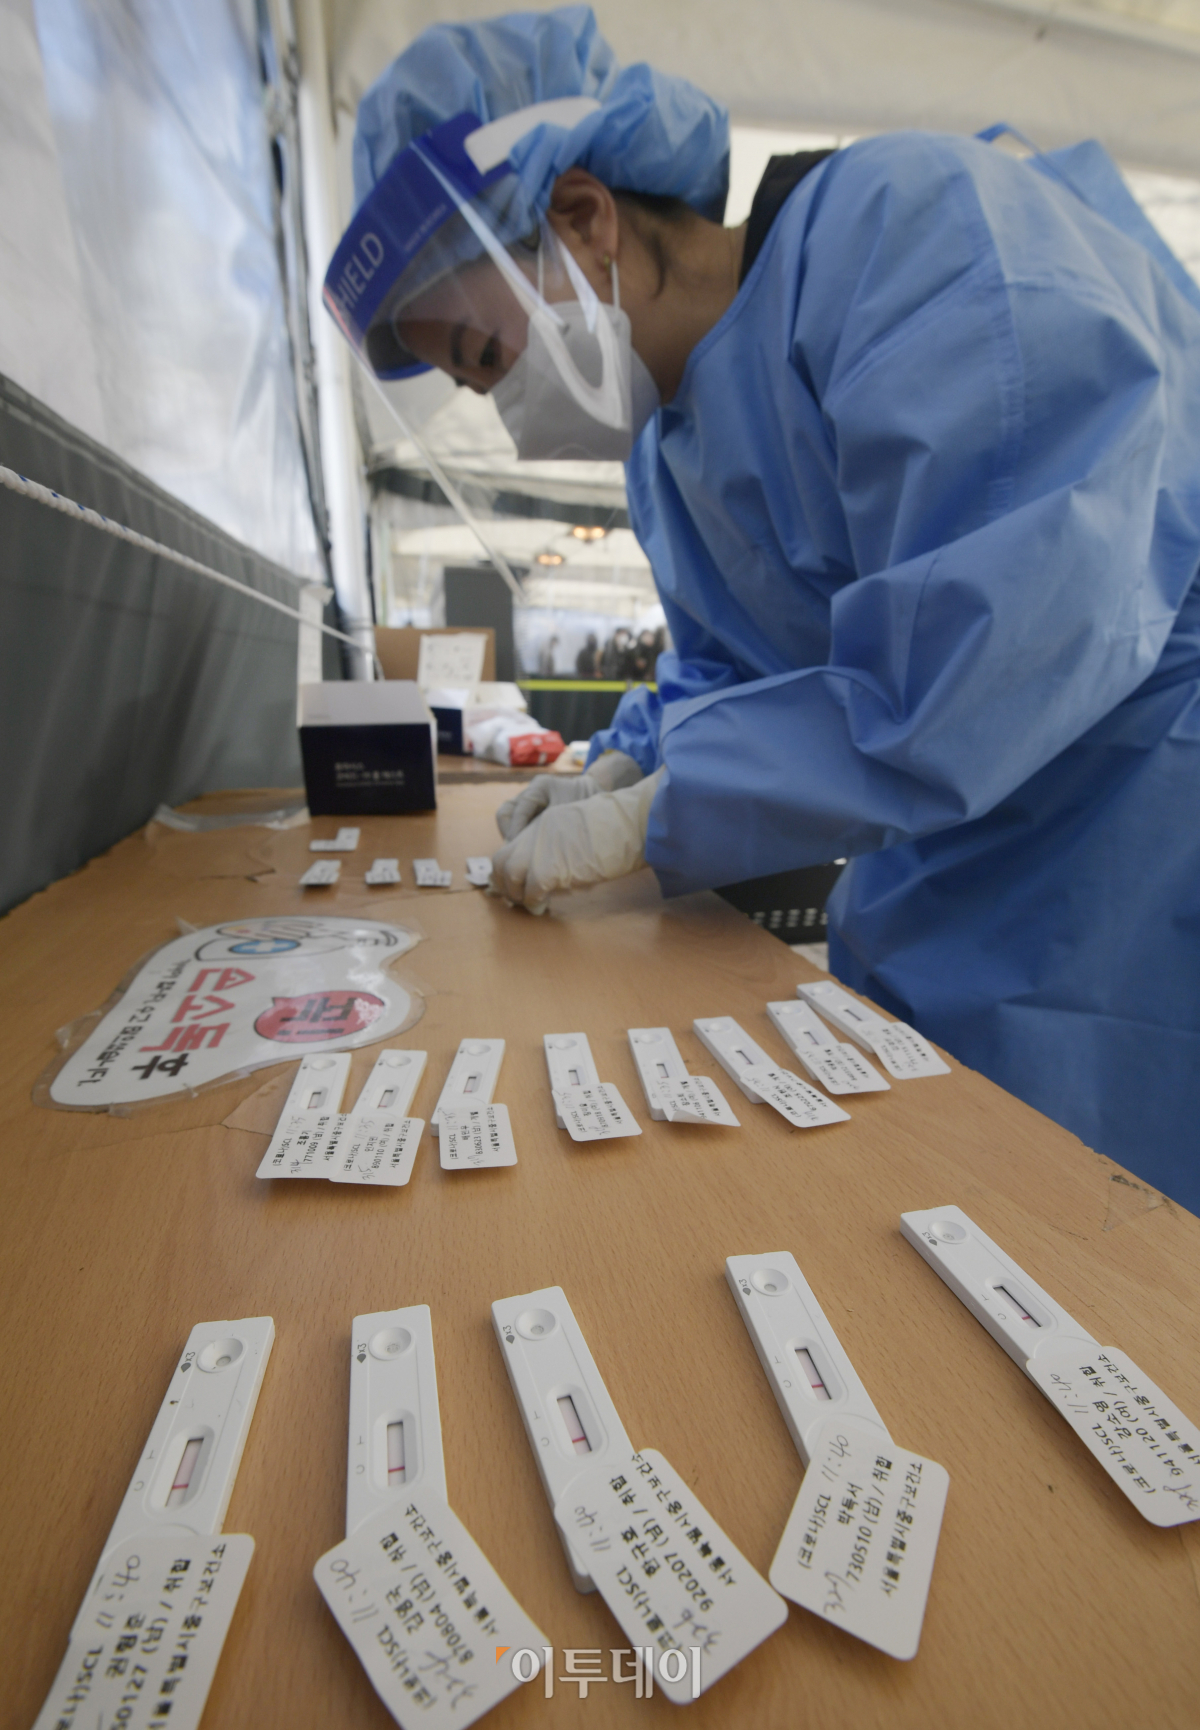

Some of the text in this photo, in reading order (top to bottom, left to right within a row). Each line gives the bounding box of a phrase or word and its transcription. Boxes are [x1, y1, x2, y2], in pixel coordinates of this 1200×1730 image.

[131, 967, 256, 1080] 손소독 후
[311, 1130, 324, 1141] (남)
[471, 1124, 482, 1135] (남)
[1078, 1365, 1106, 1387] 취합
[1091, 1399, 1132, 1439] 강소영
[1097, 1353, 1200, 1465] 서울특별시중구보건소
[1112, 1399, 1139, 1423] (여)
[820, 1433, 851, 1482] 11:40
[1091, 1422, 1156, 1494] (코로나)SCL
[1134, 1426, 1183, 1476] 941120
[609, 1474, 636, 1506] 취합
[836, 1481, 863, 1525] 박득서
[631, 1450, 733, 1584] 서울특별시중구보건소
[641, 1517, 669, 1547] (남)
[798, 1493, 831, 1569] (코로나)SCL
[845, 1455, 893, 1581] 730510 (남) / 취합
[882, 1462, 922, 1593] 서울특별시중구보건소
[162, 1558, 191, 1592] 취합
[620, 1525, 660, 1577] 한규호
[158, 1599, 173, 1611] /
[380, 1531, 474, 1664] 870804 (남) / 취합
[663, 1551, 713, 1611] 920207
[616, 1566, 681, 1650] (코로나)SCL
[140, 1616, 168, 1654] (남)
[376, 1624, 436, 1707] (코로나)SCL
